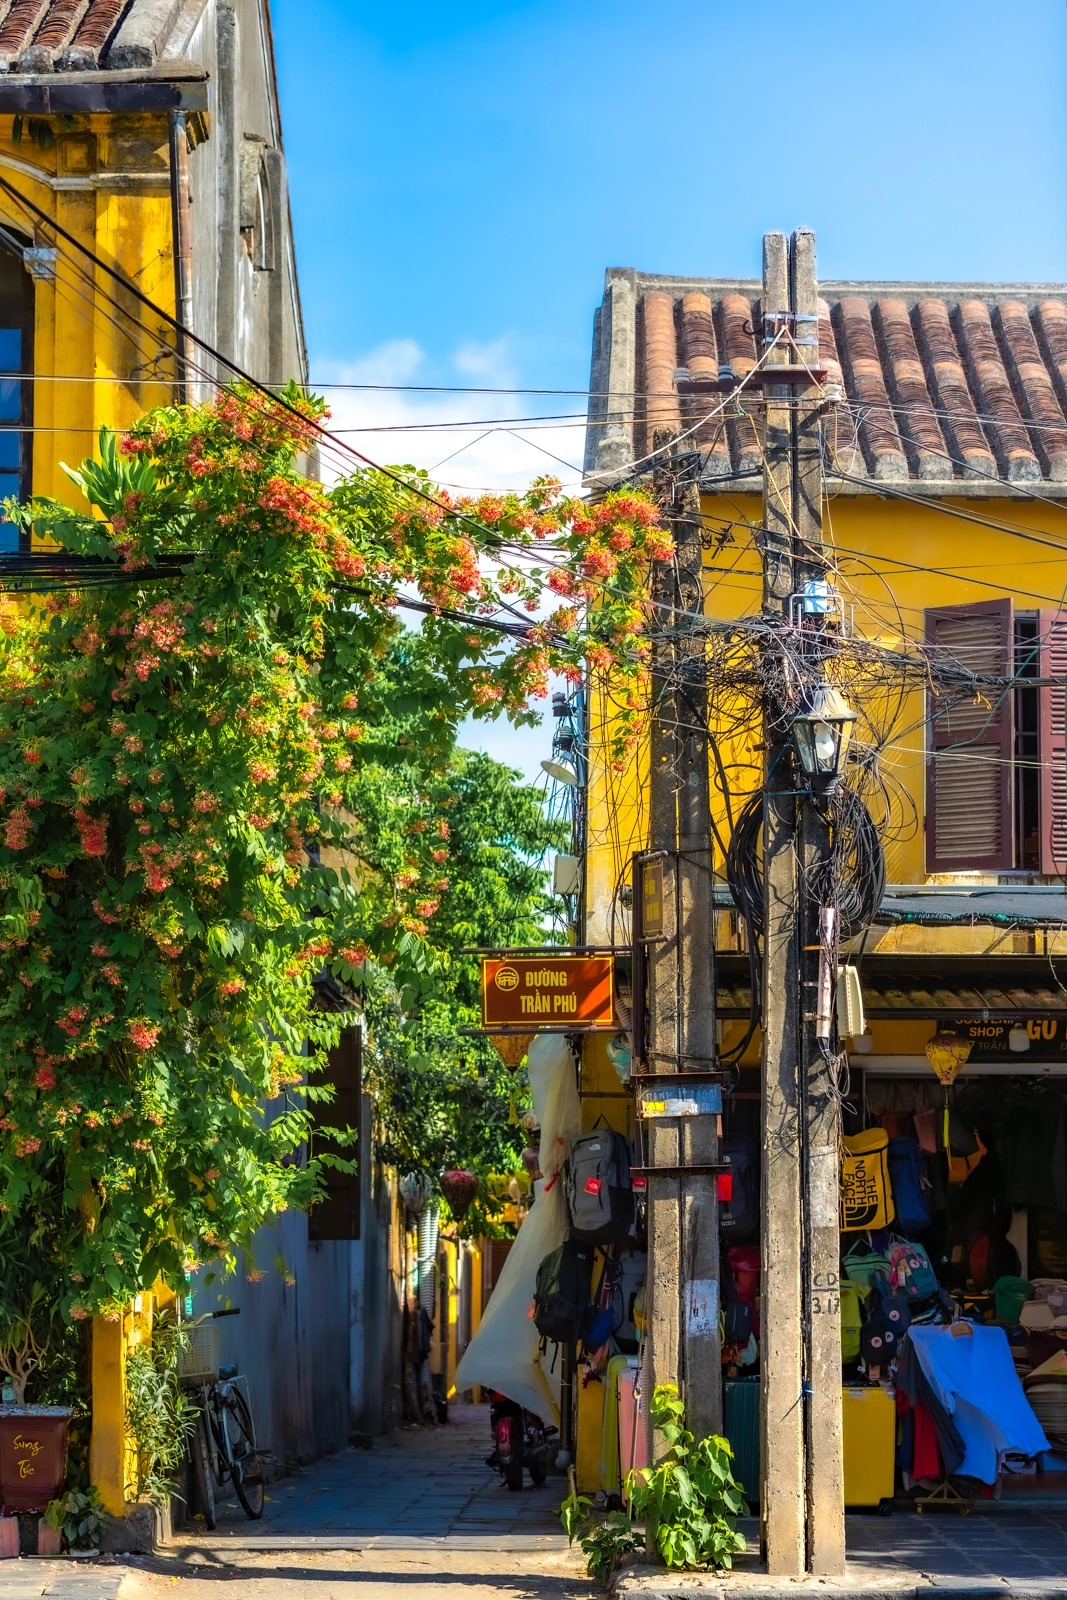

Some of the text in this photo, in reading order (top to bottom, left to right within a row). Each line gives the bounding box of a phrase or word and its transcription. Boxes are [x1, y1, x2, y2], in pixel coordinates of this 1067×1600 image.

[525, 968, 568, 987] ĐƯỜNG
[520, 989, 577, 1013] TRẦN PHÚ
[969, 1026, 1004, 1037] SHOP
[844, 1172, 856, 1205] FACE
[854, 1159, 868, 1206] NORTH
[867, 1175, 879, 1205] THE
[813, 1272, 837, 1287] CD
